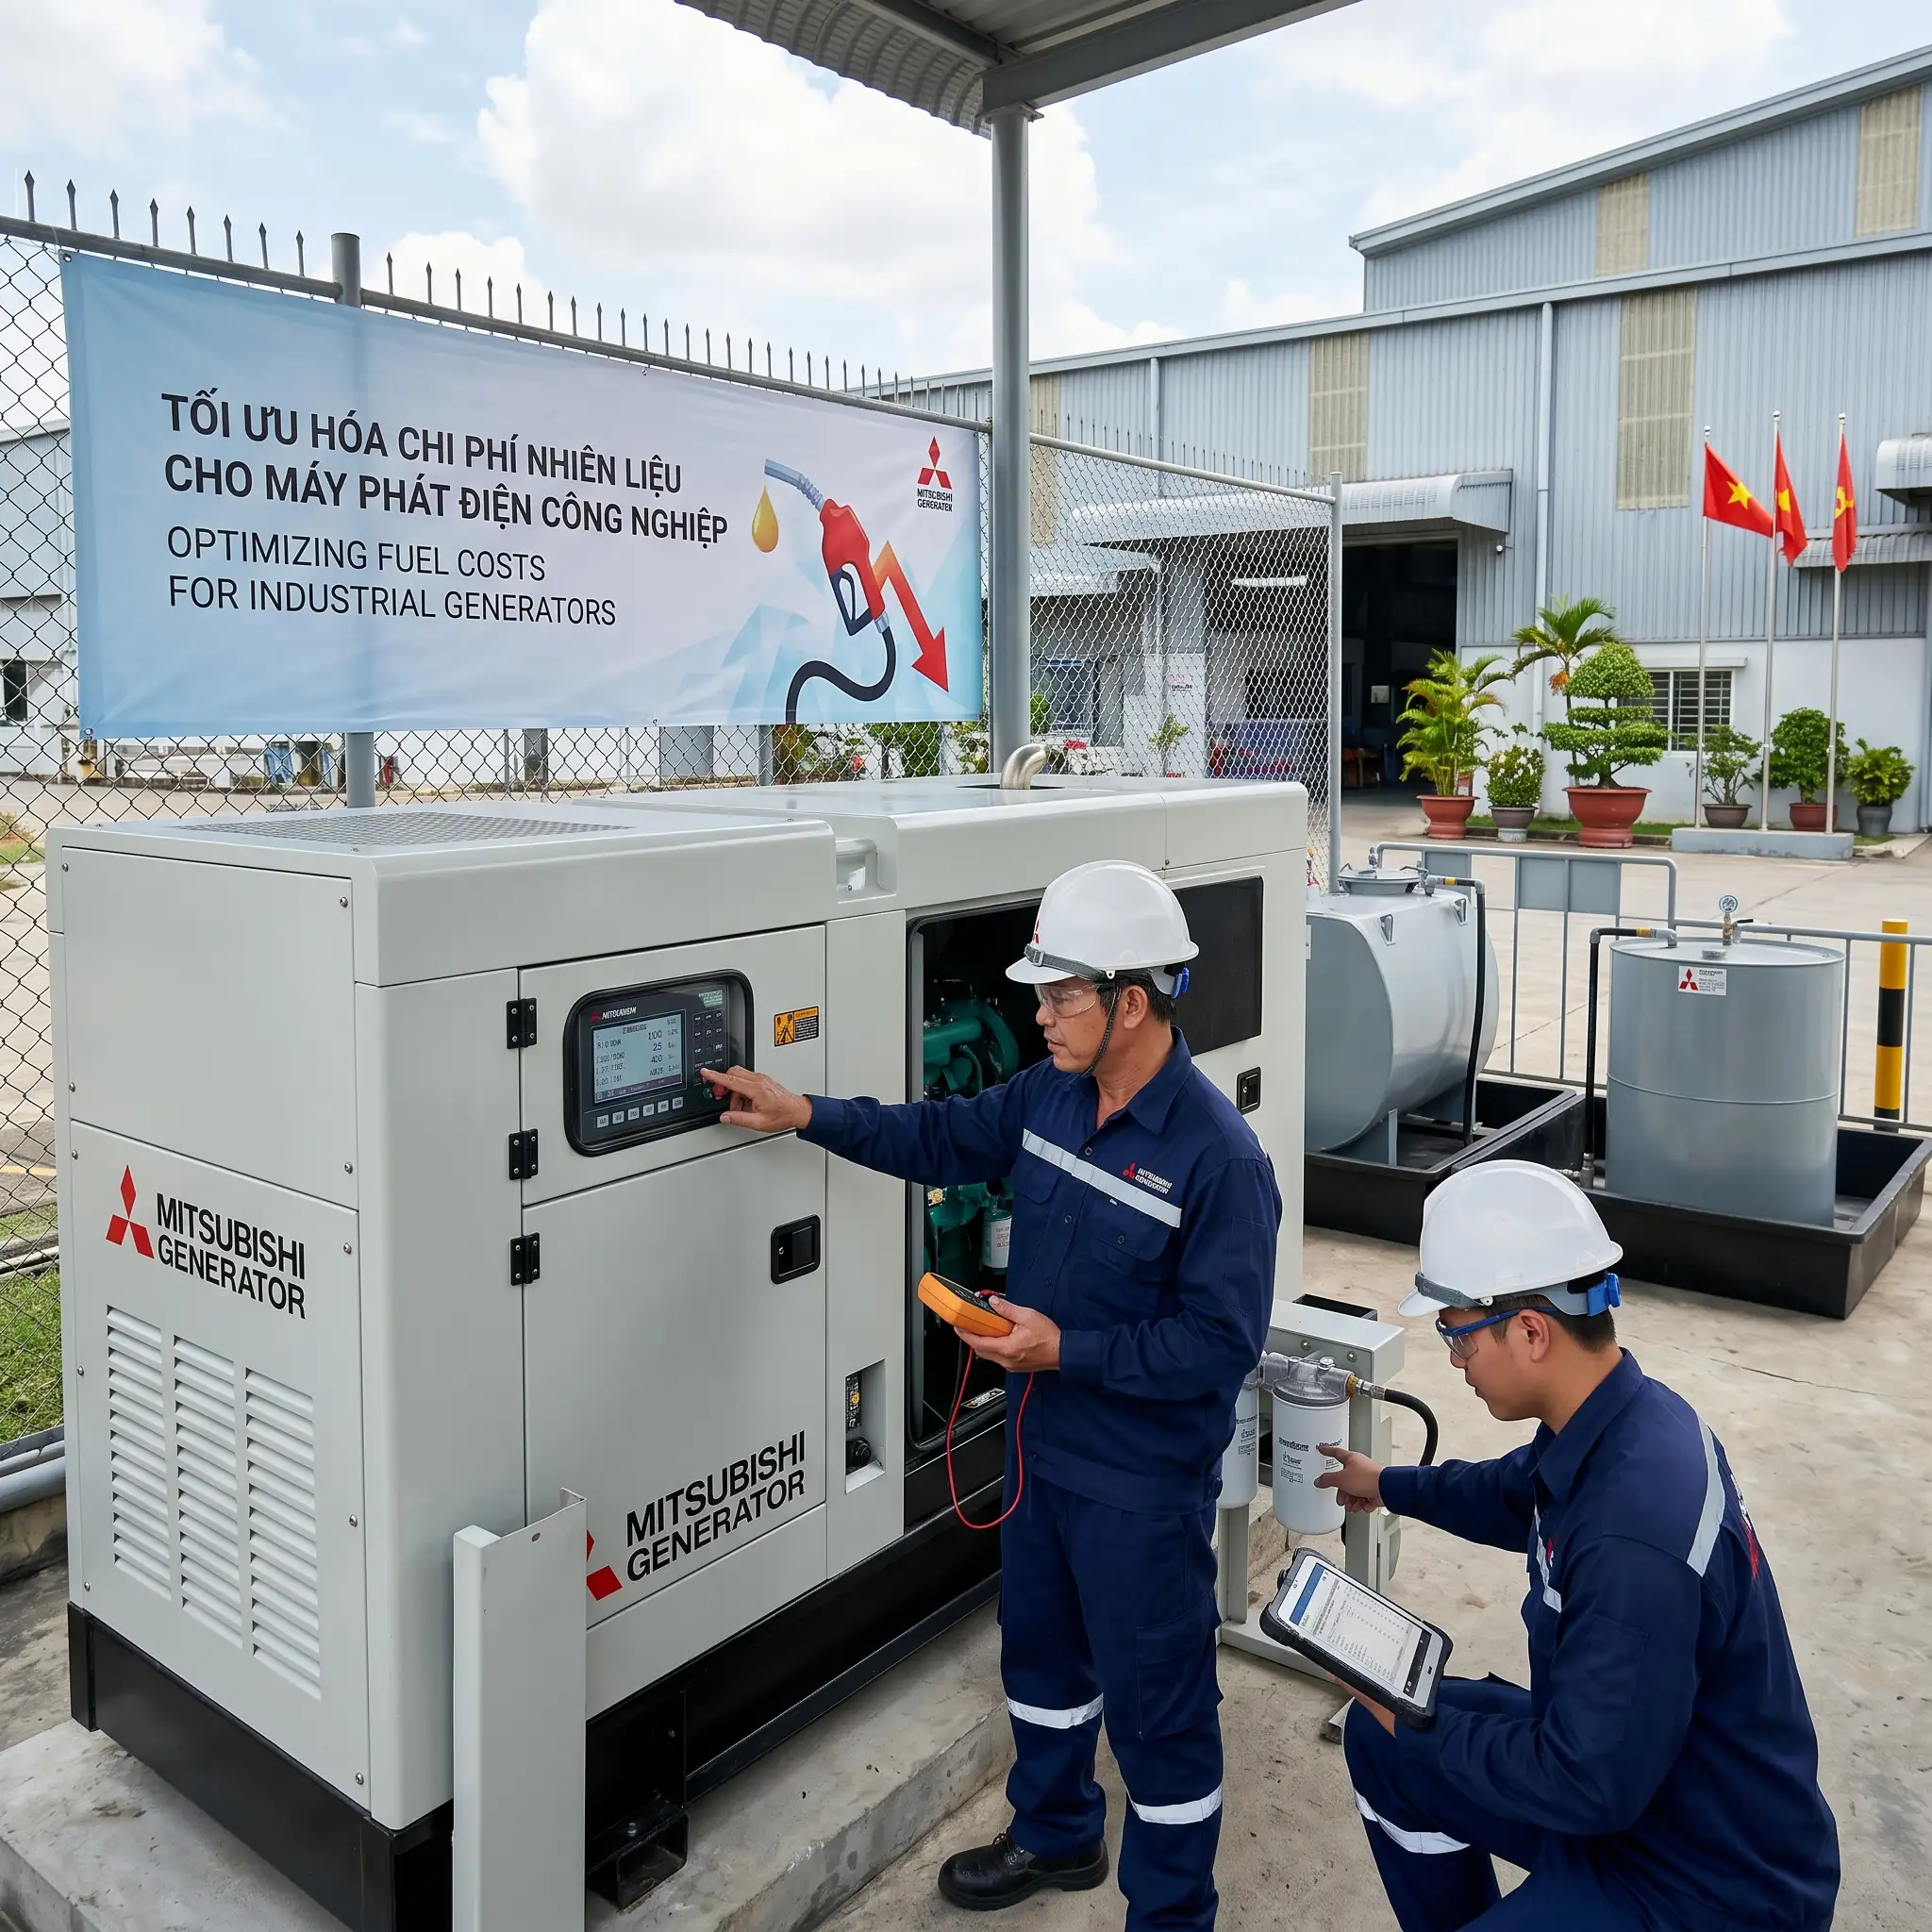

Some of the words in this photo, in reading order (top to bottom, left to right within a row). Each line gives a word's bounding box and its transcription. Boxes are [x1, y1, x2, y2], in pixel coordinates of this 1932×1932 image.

[161, 388, 229, 438] TỐI
[243, 404, 297, 445] ƯU
[311, 409, 389, 458] HÓA
[398, 426, 454, 465] CHI
[465, 434, 519, 473] PHÍ
[527, 444, 615, 486] NHIÊN
[625, 454, 681, 498] LIỆU
[165, 454, 253, 497] CHO
[265, 460, 347, 507] MÁY
[358, 473, 451, 517] PHÁT
[458, 483, 532, 530] ĐIỆN
[541, 491, 622, 534] CÔNG
[631, 507, 728, 549] NGHIỆP
[167, 525, 367, 570] OPTIMIZING
[378, 542, 449, 575] FUEL
[458, 549, 545, 581] COSTS
[169, 575, 239, 609] FOR
[250, 580, 436, 618] INDUSTRIAL
[444, 591, 616, 625] GENERATORS
[157, 1192, 305, 1280] MITSUBISHI
[158, 1234, 306, 1320] GENERATOR
[626, 1430, 805, 1547] MITSUBISHI
[626, 1469, 805, 1582] GENERATOR
